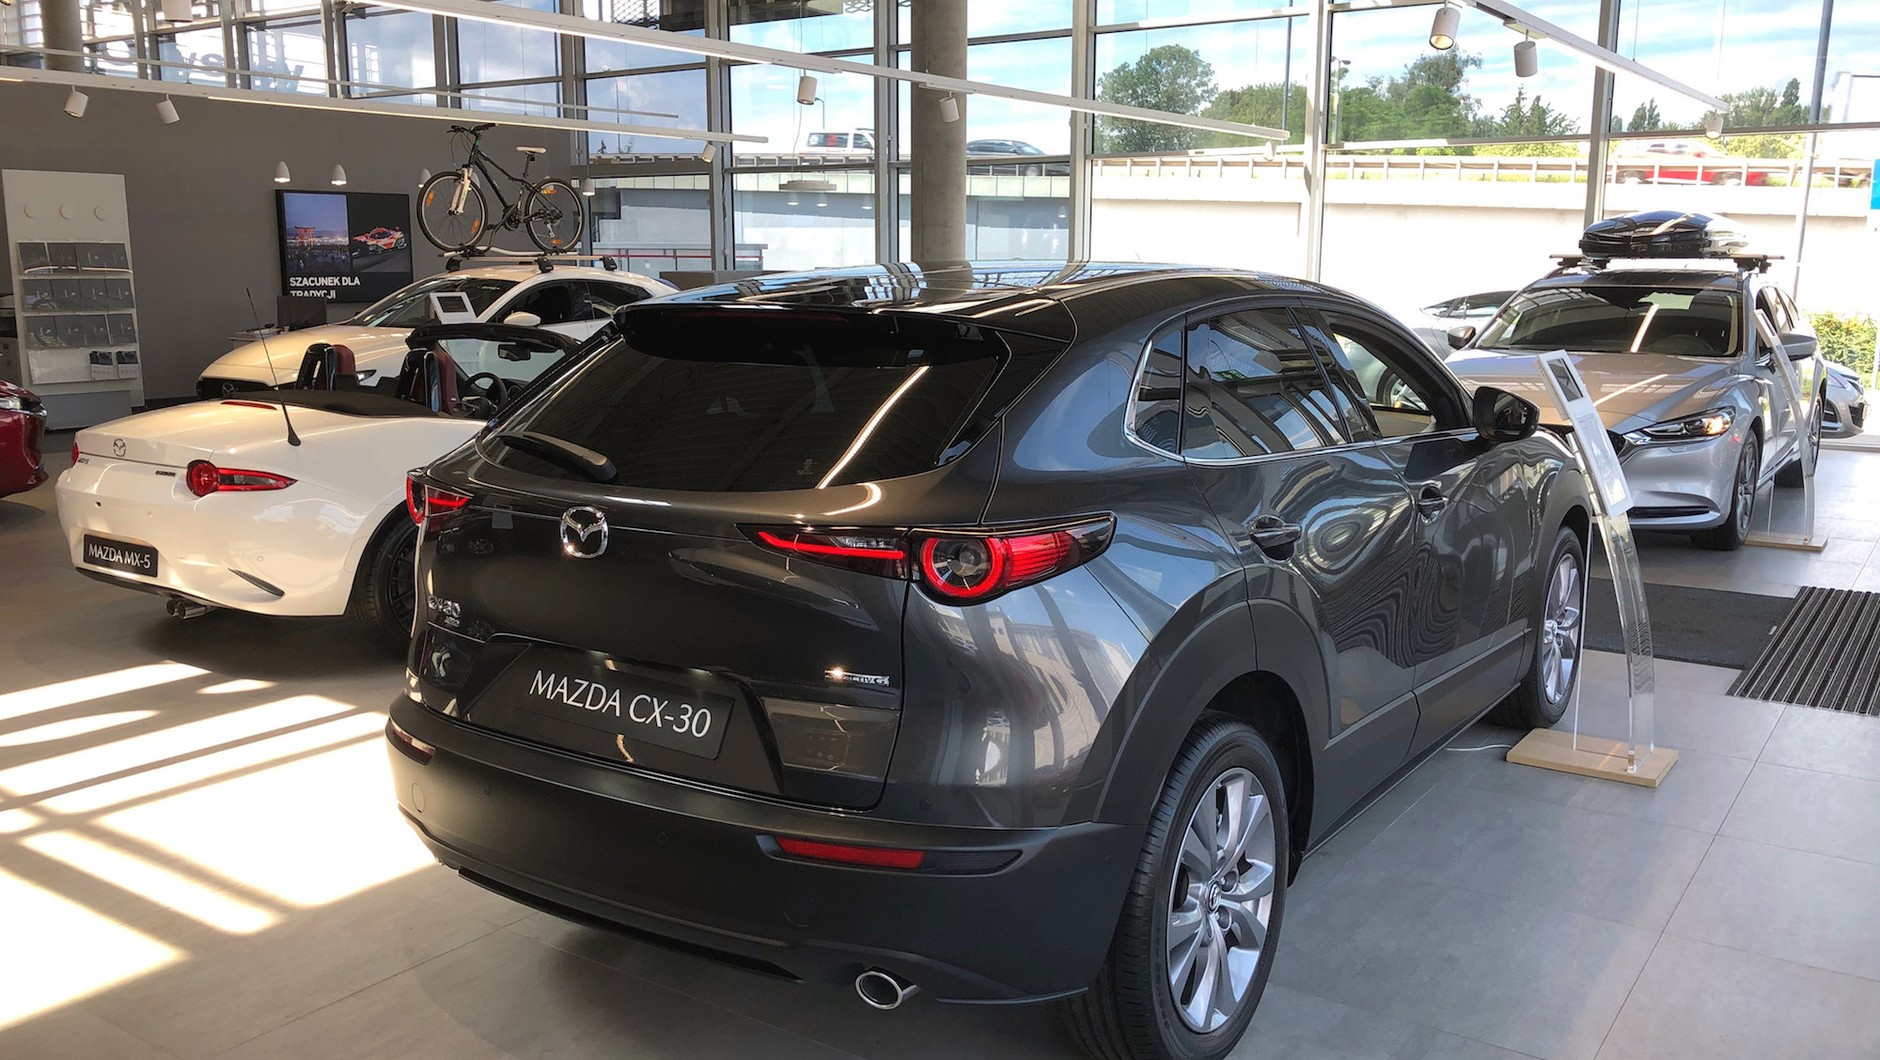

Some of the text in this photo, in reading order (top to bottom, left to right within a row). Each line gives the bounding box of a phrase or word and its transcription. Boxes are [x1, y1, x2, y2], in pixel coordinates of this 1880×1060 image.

[289, 276, 361, 287] SZACUNEK DLA
[88, 543, 151, 569] MAZDA MX-5
[529, 670, 712, 738] MAZDA CX-30
